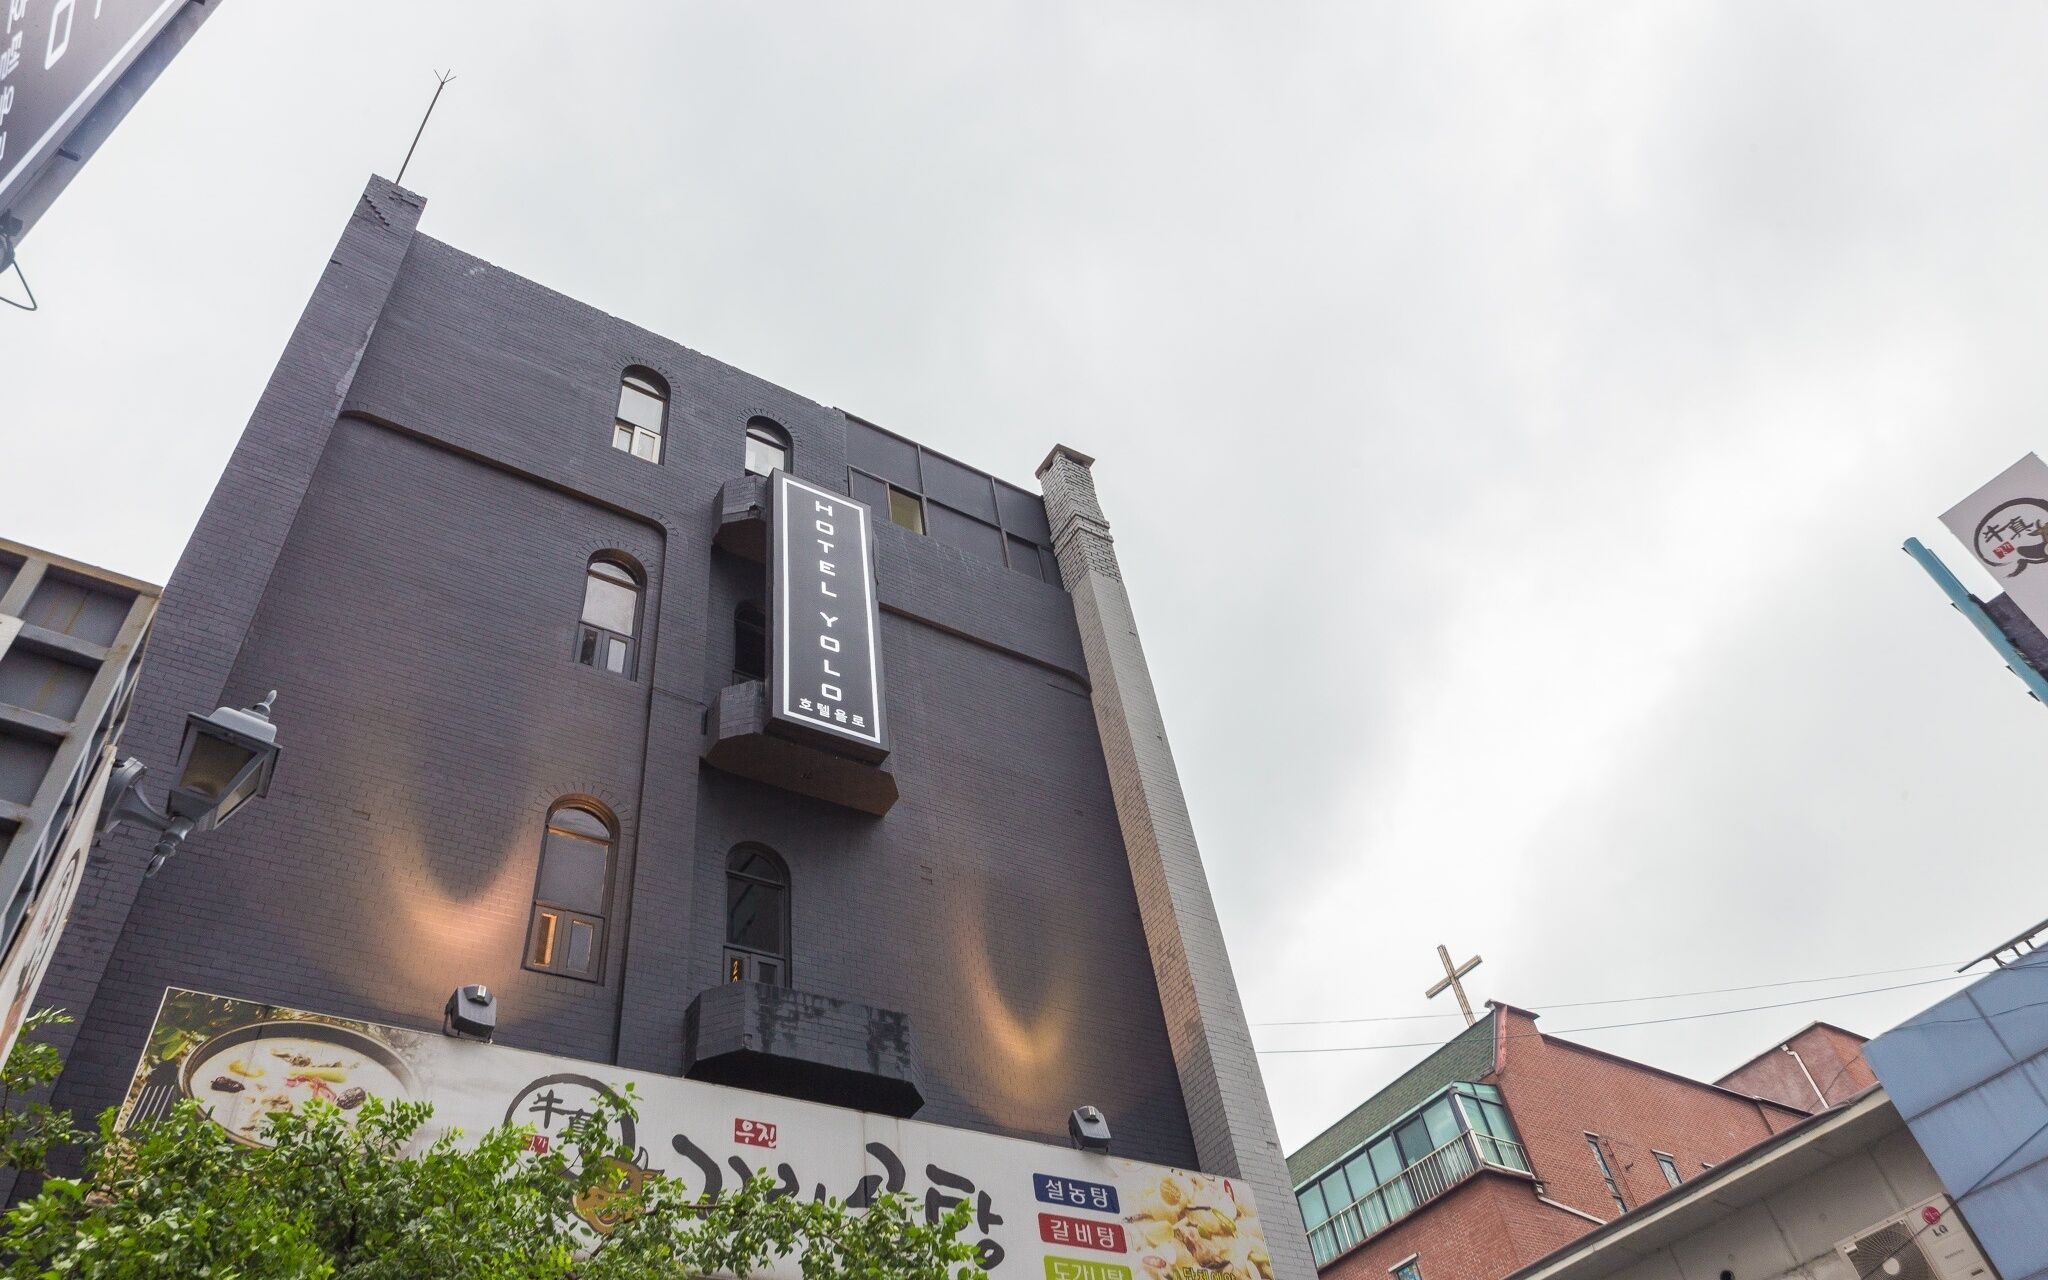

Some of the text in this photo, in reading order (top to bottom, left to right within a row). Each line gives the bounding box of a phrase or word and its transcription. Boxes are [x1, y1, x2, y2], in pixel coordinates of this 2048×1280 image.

[815, 500, 842, 702] HOTEL YOLO
[735, 1119, 776, 1148] 우진
[1045, 1179, 1108, 1208] 설농탕
[1050, 1219, 1115, 1248] 갈비탕
[1932, 1224, 1949, 1237] LG
